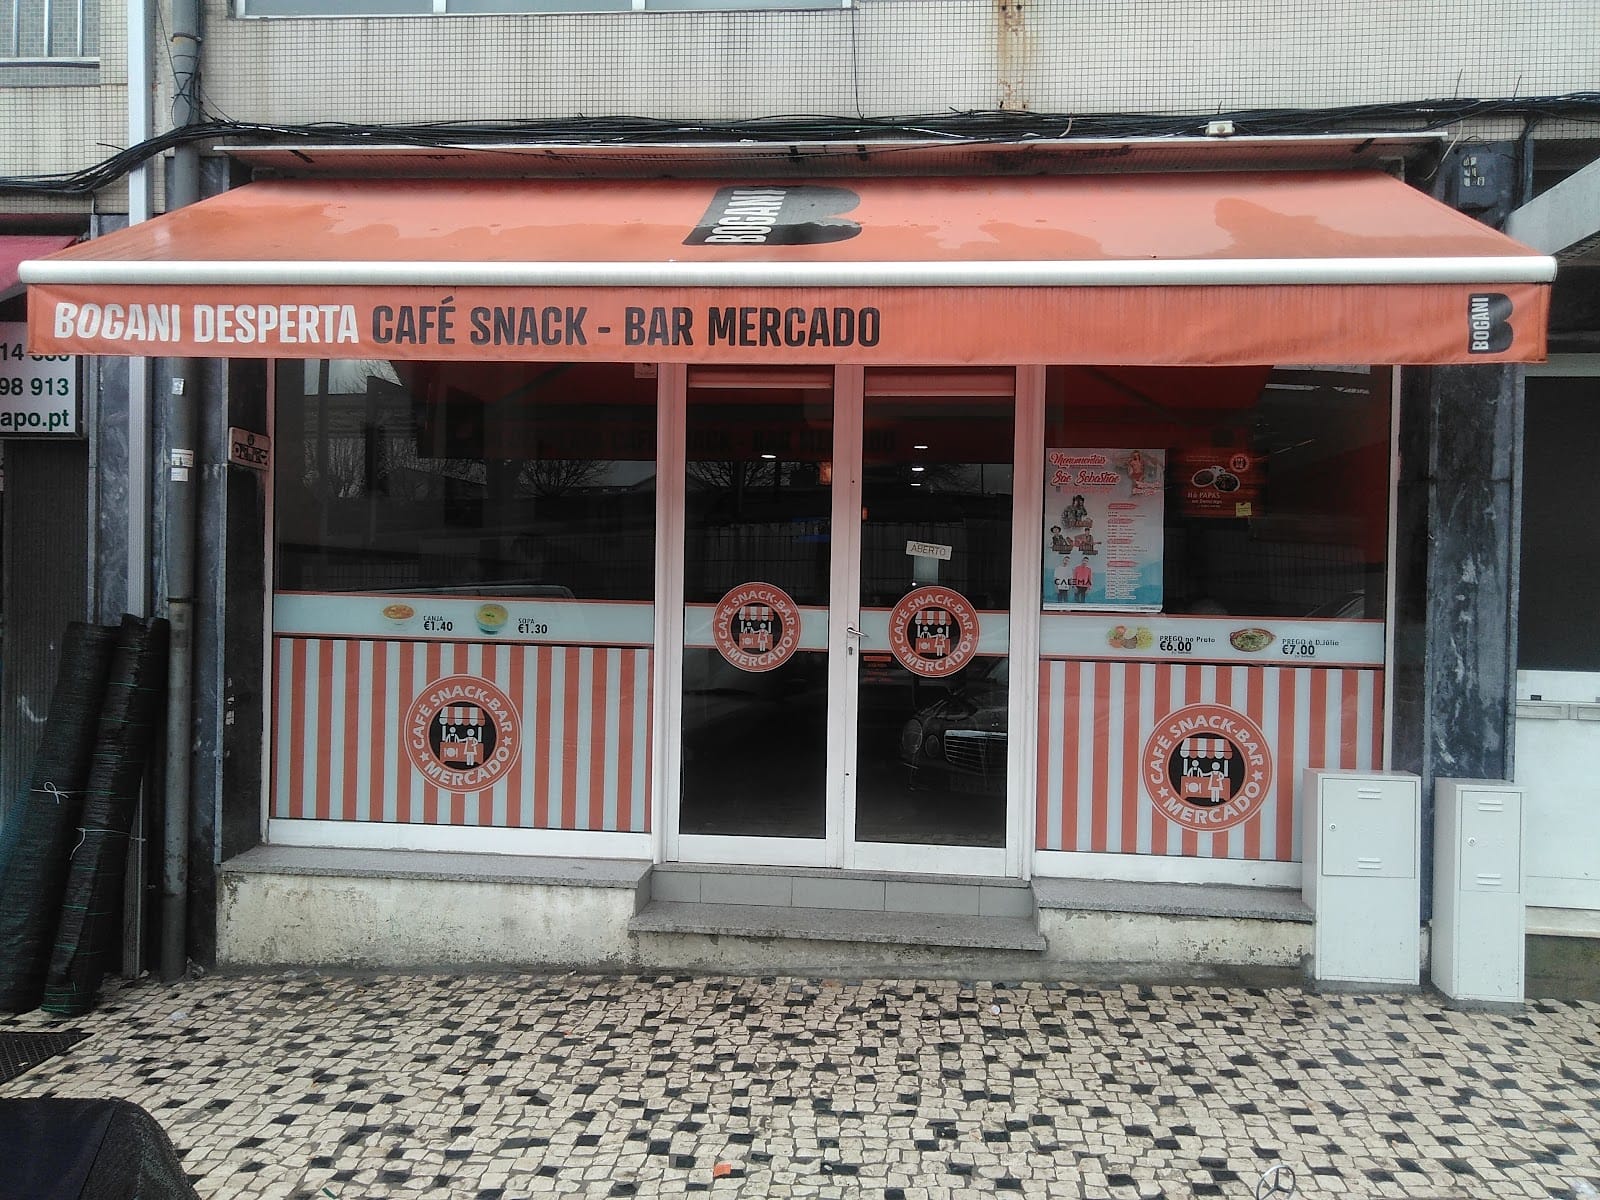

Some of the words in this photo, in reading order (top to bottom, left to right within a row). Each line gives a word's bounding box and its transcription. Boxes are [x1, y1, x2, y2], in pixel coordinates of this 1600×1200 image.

[704, 189, 787, 243] BOGANI
[53, 302, 181, 343] BOGANI
[193, 303, 360, 345] DESPERTA
[372, 295, 456, 346] CAFÉ
[469, 306, 588, 347] SNACK
[597, 325, 611, 334] -
[624, 306, 694, 347] BAR
[707, 306, 881, 348] MERCADO
[1471, 297, 1490, 351] BOGANI
[30, 377, 69, 396] 913
[0, 409, 69, 432] apo.pt
[910, 543, 946, 556] ABERTO
[423, 621, 453, 632] €1.40
[517, 623, 548, 634] €1.30
[718, 604, 734, 640] CAFÉ
[731, 590, 795, 626] SNACK-BAR
[894, 608, 910, 644] CAFÉ
[907, 594, 974, 631] SNACK-BAR
[727, 636, 793, 667] MERCADO
[1159, 635, 1183, 643] PREGO
[1159, 641, 1192, 652] €6.00
[1282, 638, 1306, 646] PREGO
[1282, 644, 1315, 656] €7.00
[902, 640, 971, 672] MERCADO
[413, 704, 432, 750] CAFÉ
[430, 685, 513, 733] SNACK-BAR
[1150, 735, 1172, 784] CAFÉ
[1169, 715, 1264, 766] SNACK-BAR
[423, 746, 510, 786] MERCADO
[1163, 781, 1260, 824] MERCADO
